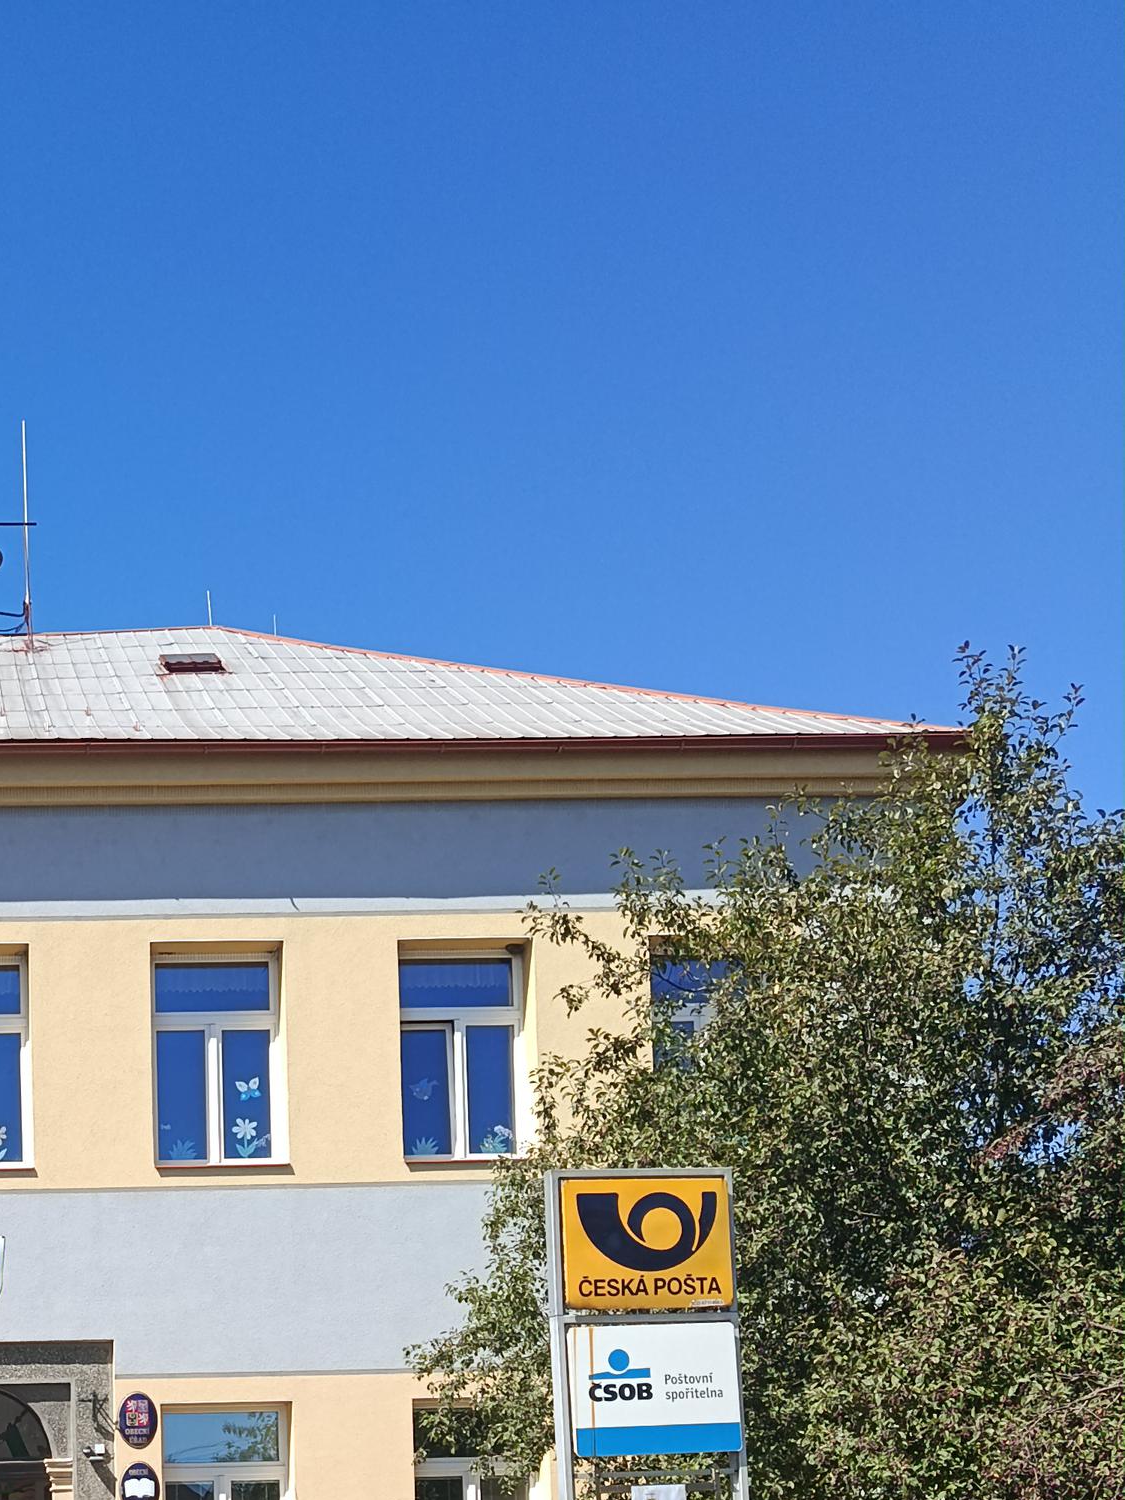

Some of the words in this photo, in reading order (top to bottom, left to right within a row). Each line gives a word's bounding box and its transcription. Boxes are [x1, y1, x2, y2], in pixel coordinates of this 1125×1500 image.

[578, 1275, 649, 1297] ČESKÁ
[653, 1274, 722, 1295] POŠTA
[664, 1372, 713, 1385] Poštovní
[588, 1382, 654, 1402] ČSOB
[665, 1387, 724, 1402] spořitelna
